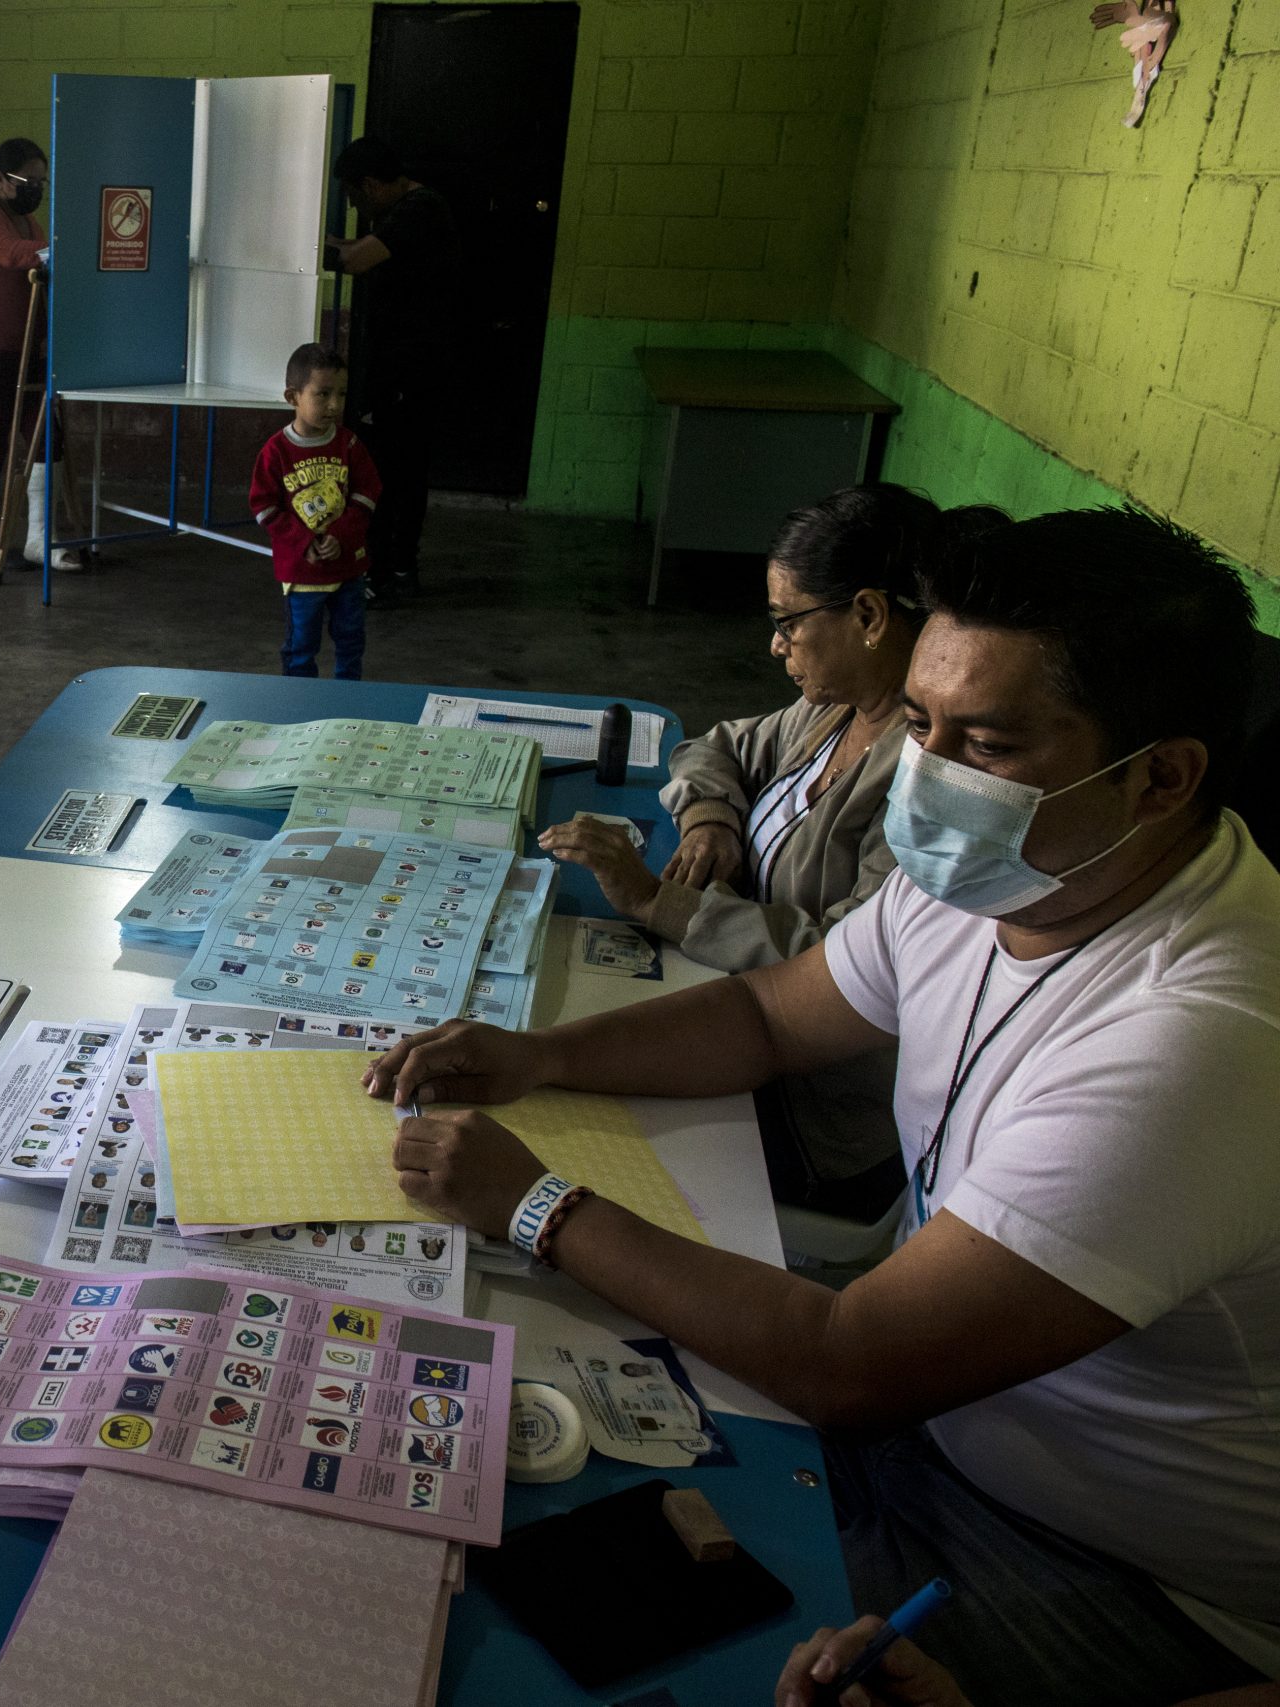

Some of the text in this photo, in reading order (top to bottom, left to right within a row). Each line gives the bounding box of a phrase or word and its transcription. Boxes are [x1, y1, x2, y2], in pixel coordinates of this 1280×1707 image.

[294, 457, 327, 469] HOOKED
[283, 464, 349, 492] SPONGEBO
[140, 699, 187, 737] DIPUTADOS
[44, 799, 87, 840] DISTRITALES
[386, 1231, 406, 1242] UNE
[17, 1277, 41, 1298] UNE
[100, 1286, 118, 1306] VIVA
[348, 1309, 361, 1331] PAN
[261, 1330, 278, 1357] VALOR
[46, 1385, 58, 1402] PIN
[147, 1384, 162, 1407] TODOS
[349, 1382, 363, 1414] VICTORIA
[246, 1402, 261, 1433] PODEMOS
[449, 1402, 458, 1424] CREO
[349, 1422, 362, 1454] NOSOTROS
[425, 1436, 434, 1451] FCN
[440, 1434, 455, 1470] NACIÓN
[314, 1456, 328, 1487] CAMBIO
[410, 1471, 434, 1508] VOS
